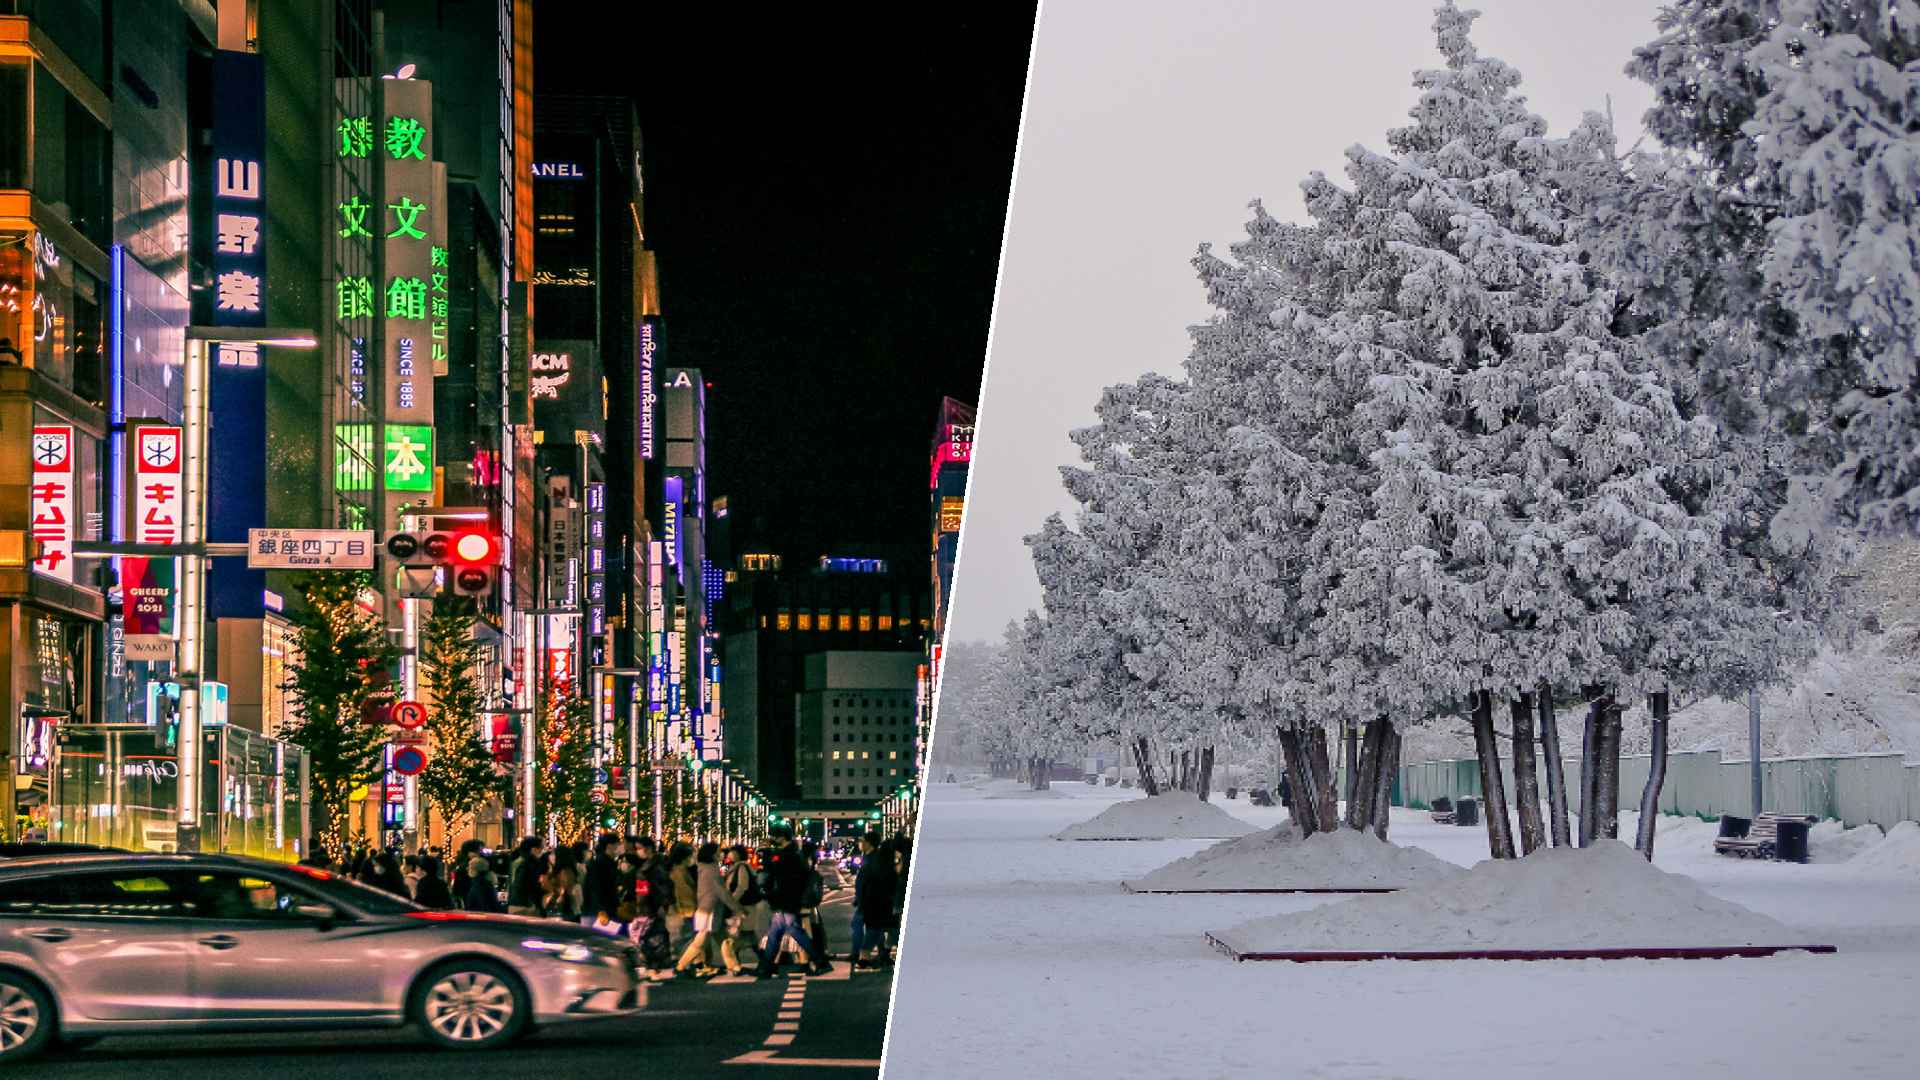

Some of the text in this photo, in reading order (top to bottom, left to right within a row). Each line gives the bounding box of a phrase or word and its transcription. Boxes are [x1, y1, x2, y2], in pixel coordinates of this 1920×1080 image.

[386, 116, 427, 319] 教文館
[432, 246, 448, 361] 教文館ビル
[400, 338, 414, 409] SINCE 1885
[387, 436, 426, 481] 本
[258, 539, 365, 555] 銀座四丁目
[288, 556, 320, 565] Ginza
[130, 588, 169, 597] CHEERS
[137, 604, 163, 612] 2021
[134, 643, 168, 652] WAKO
